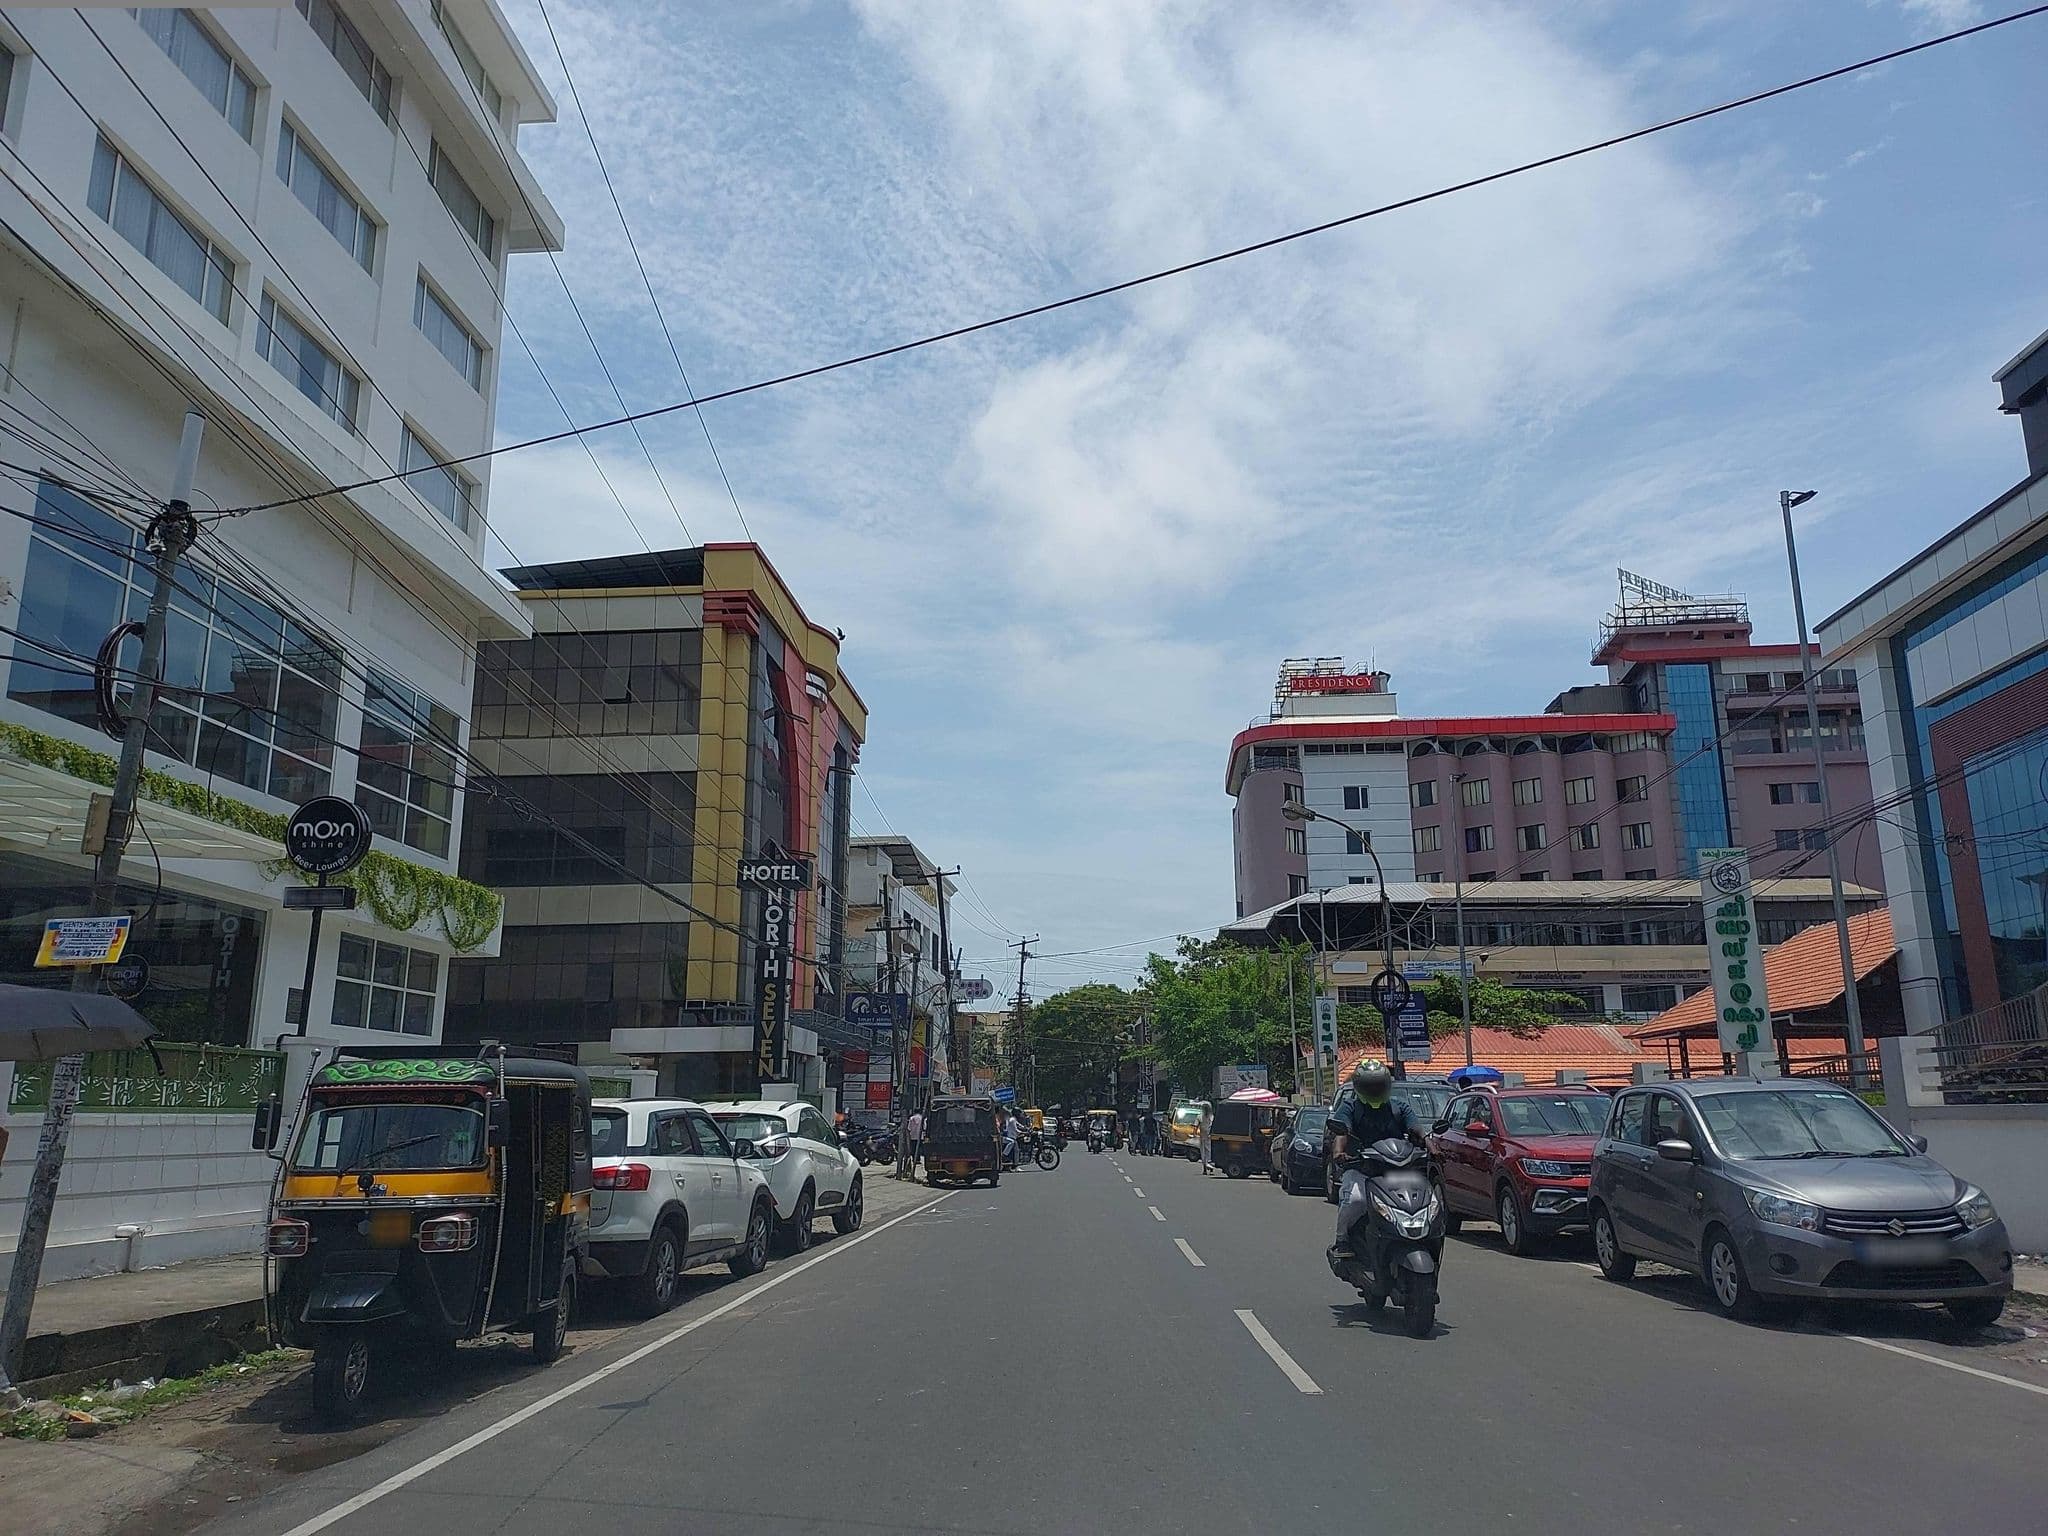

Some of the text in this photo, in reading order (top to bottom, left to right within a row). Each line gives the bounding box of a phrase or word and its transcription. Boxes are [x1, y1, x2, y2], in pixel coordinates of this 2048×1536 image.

[1291, 677, 1372, 689] PRESIDENCY
[293, 820, 355, 839] moon
[293, 854, 349, 871] Beer Lounge
[742, 865, 800, 881] HOTEL
[758, 887, 784, 1078] NORTH SEVEN
